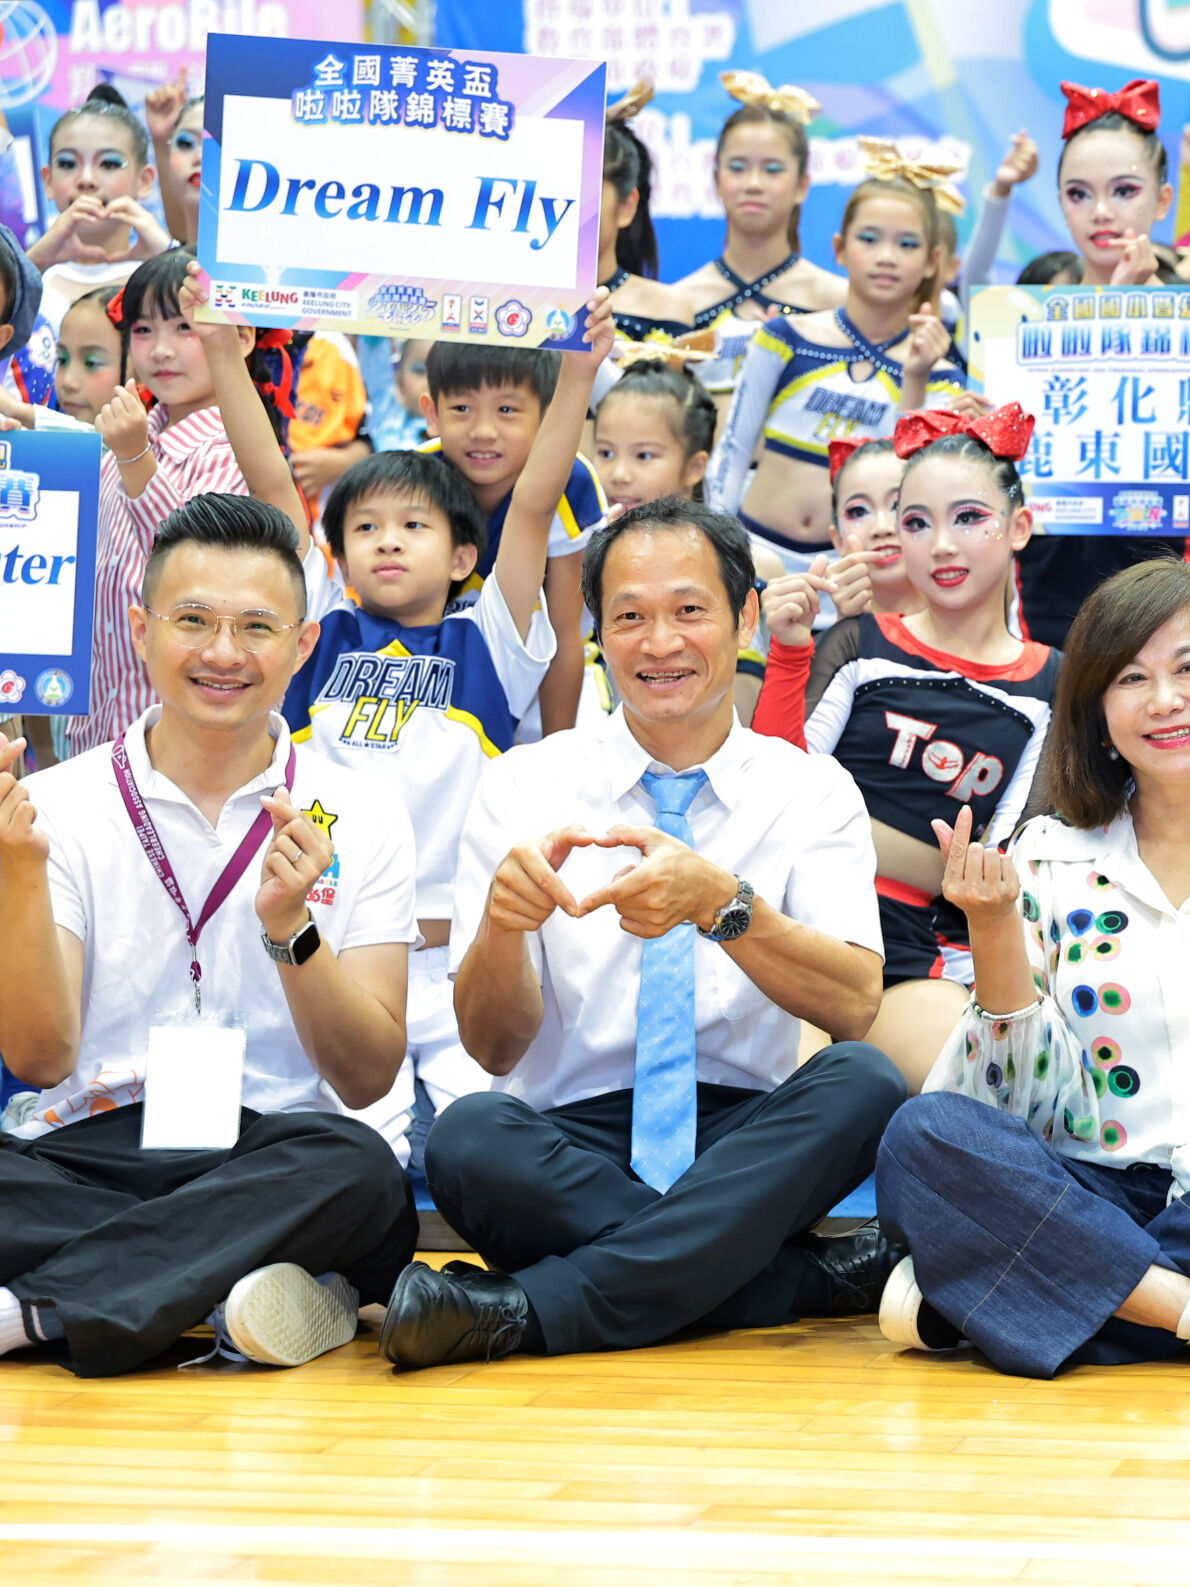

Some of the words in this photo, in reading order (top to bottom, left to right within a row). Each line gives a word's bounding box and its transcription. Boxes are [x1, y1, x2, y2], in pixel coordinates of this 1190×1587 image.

[314, 53, 494, 98] 全國菁英盃
[294, 88, 510, 136] 啦啦隊錦標賽
[223, 158, 446, 227] Dream
[463, 175, 577, 251] Fly
[241, 288, 299, 304] KEELUNG
[803, 386, 889, 427] DREAM
[318, 655, 455, 711] DREAM
[342, 696, 421, 742] FLY
